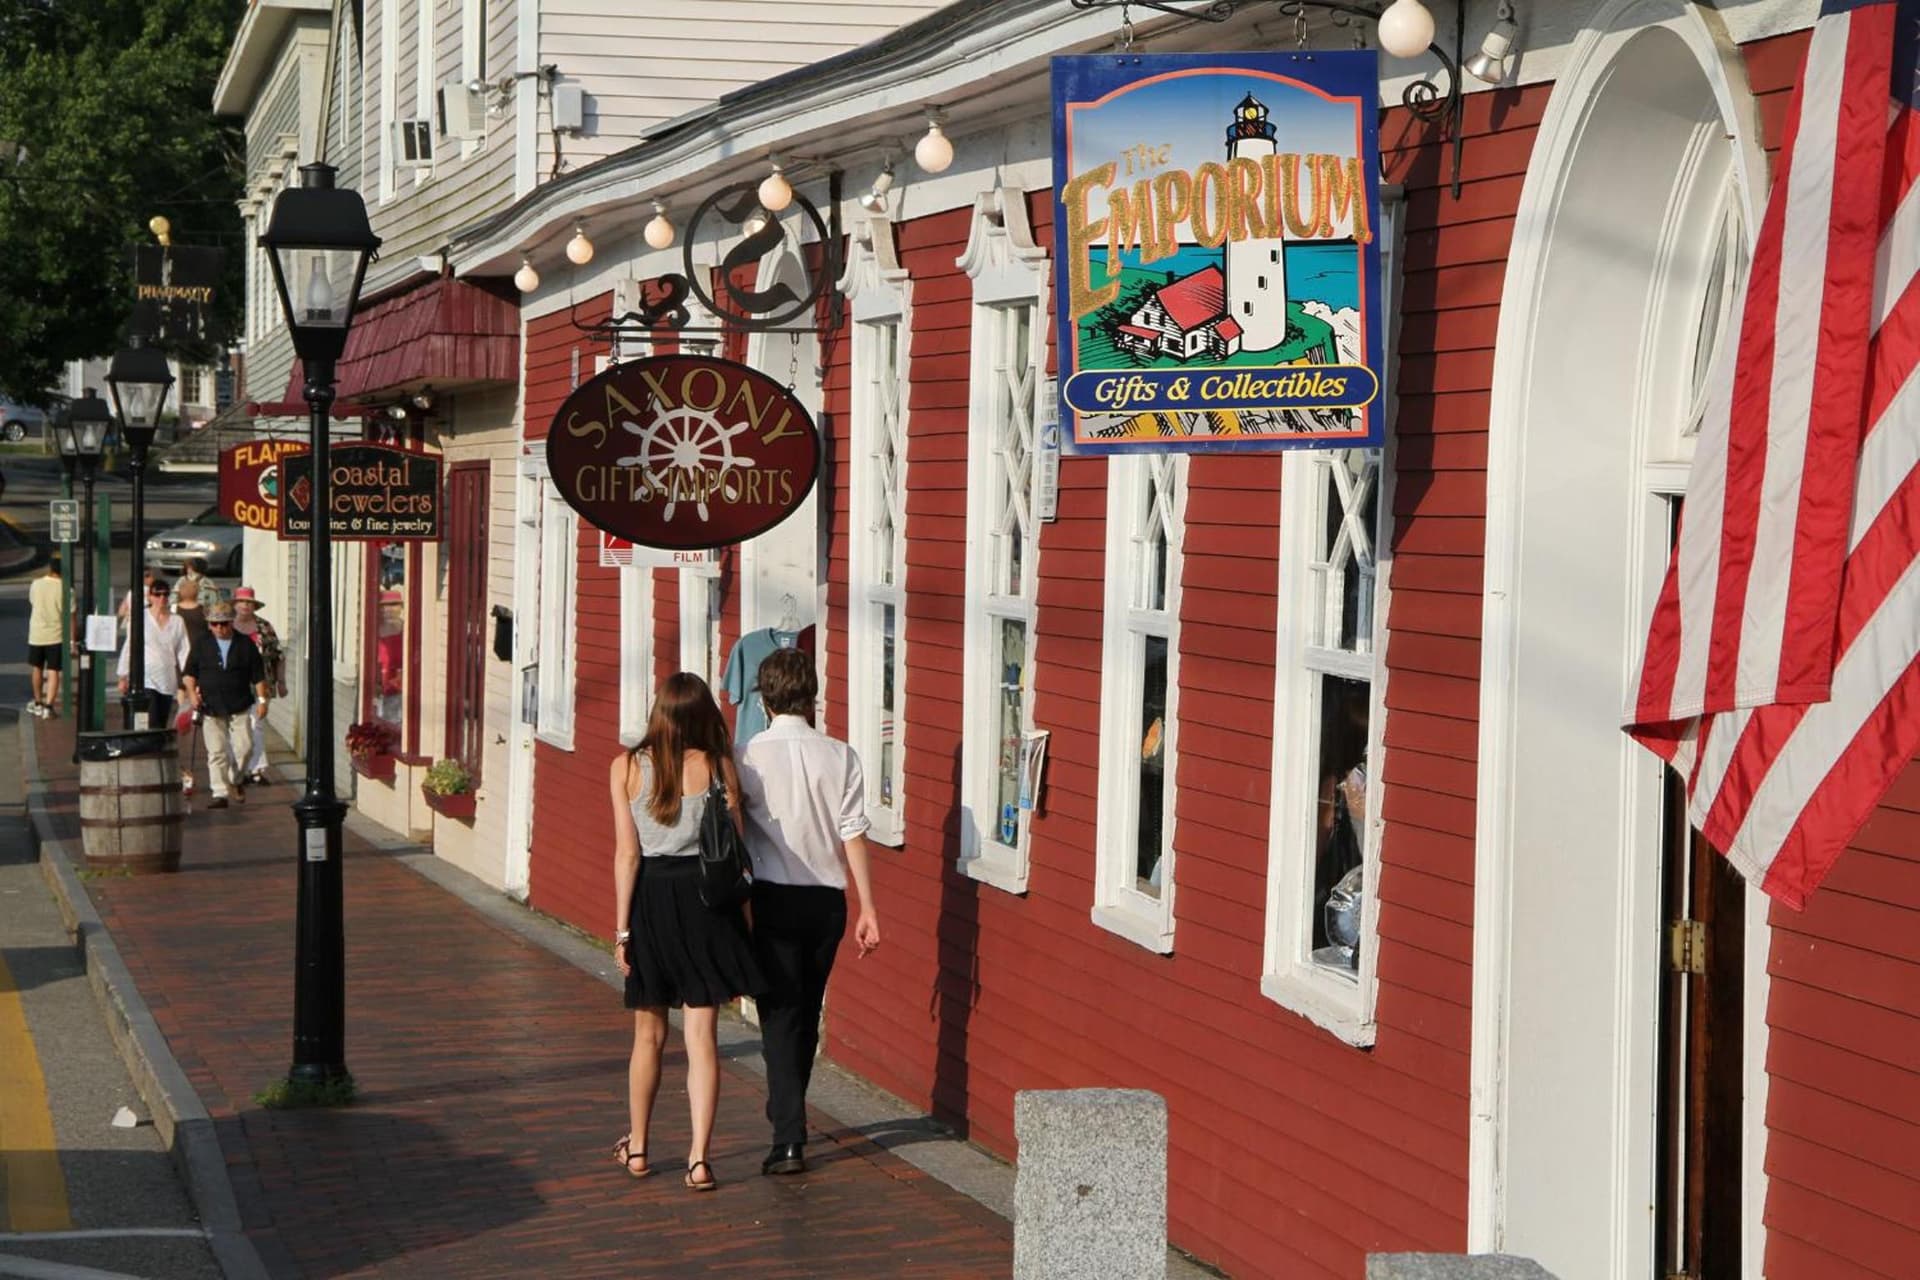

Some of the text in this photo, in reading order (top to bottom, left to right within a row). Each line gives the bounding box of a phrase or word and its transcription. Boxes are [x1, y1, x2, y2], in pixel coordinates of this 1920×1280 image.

[1120, 143, 1172, 176] The
[1095, 372, 1347, 408] Gifts & Collectibles
[567, 367, 804, 449] SAXONY
[329, 458, 409, 486] oastal
[366, 517, 389, 530] fine
[391, 518, 432, 534] jewelry
[673, 552, 703, 562] FILM
